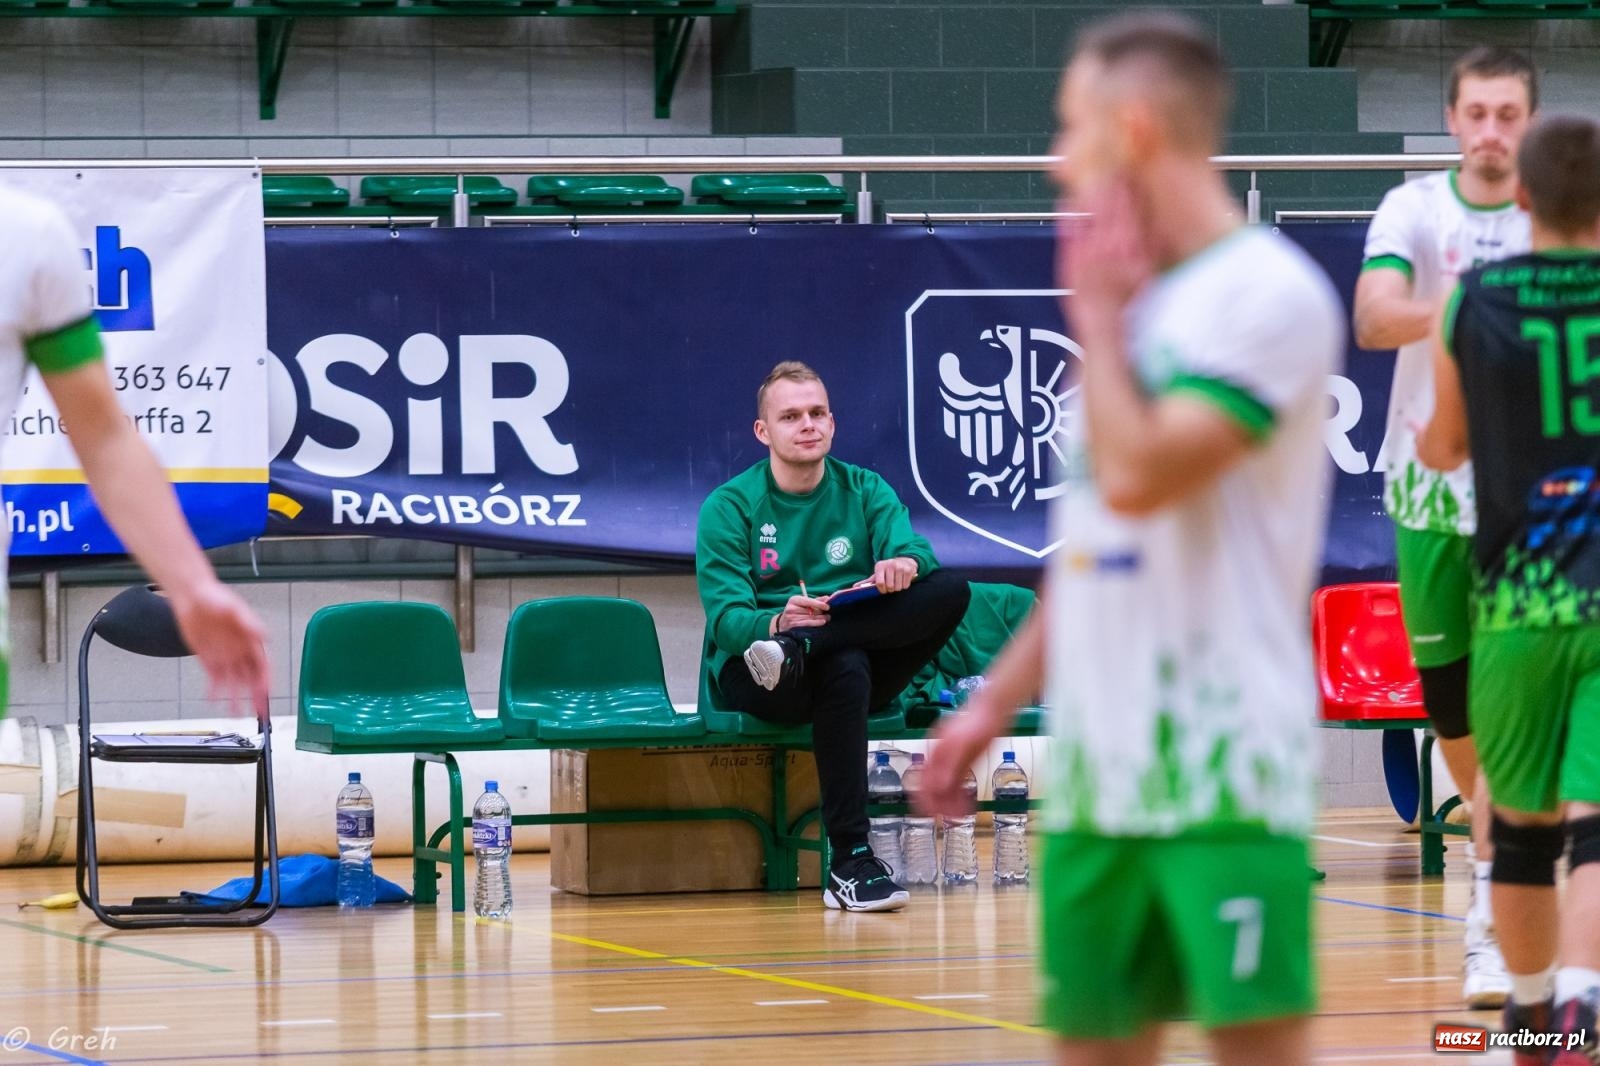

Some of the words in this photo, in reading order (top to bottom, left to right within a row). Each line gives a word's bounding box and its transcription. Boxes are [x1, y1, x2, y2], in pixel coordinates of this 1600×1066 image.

[114, 364, 165, 391] 363
[177, 365, 231, 391] 647
[1520, 317, 1600, 437] 15
[196, 410, 213, 433] 2
[331, 482, 587, 526] RACIBÓRZ
[760, 548, 780, 571] R
[710, 752, 796, 769] Aqua-Spt
[1217, 896, 1264, 981] 7
